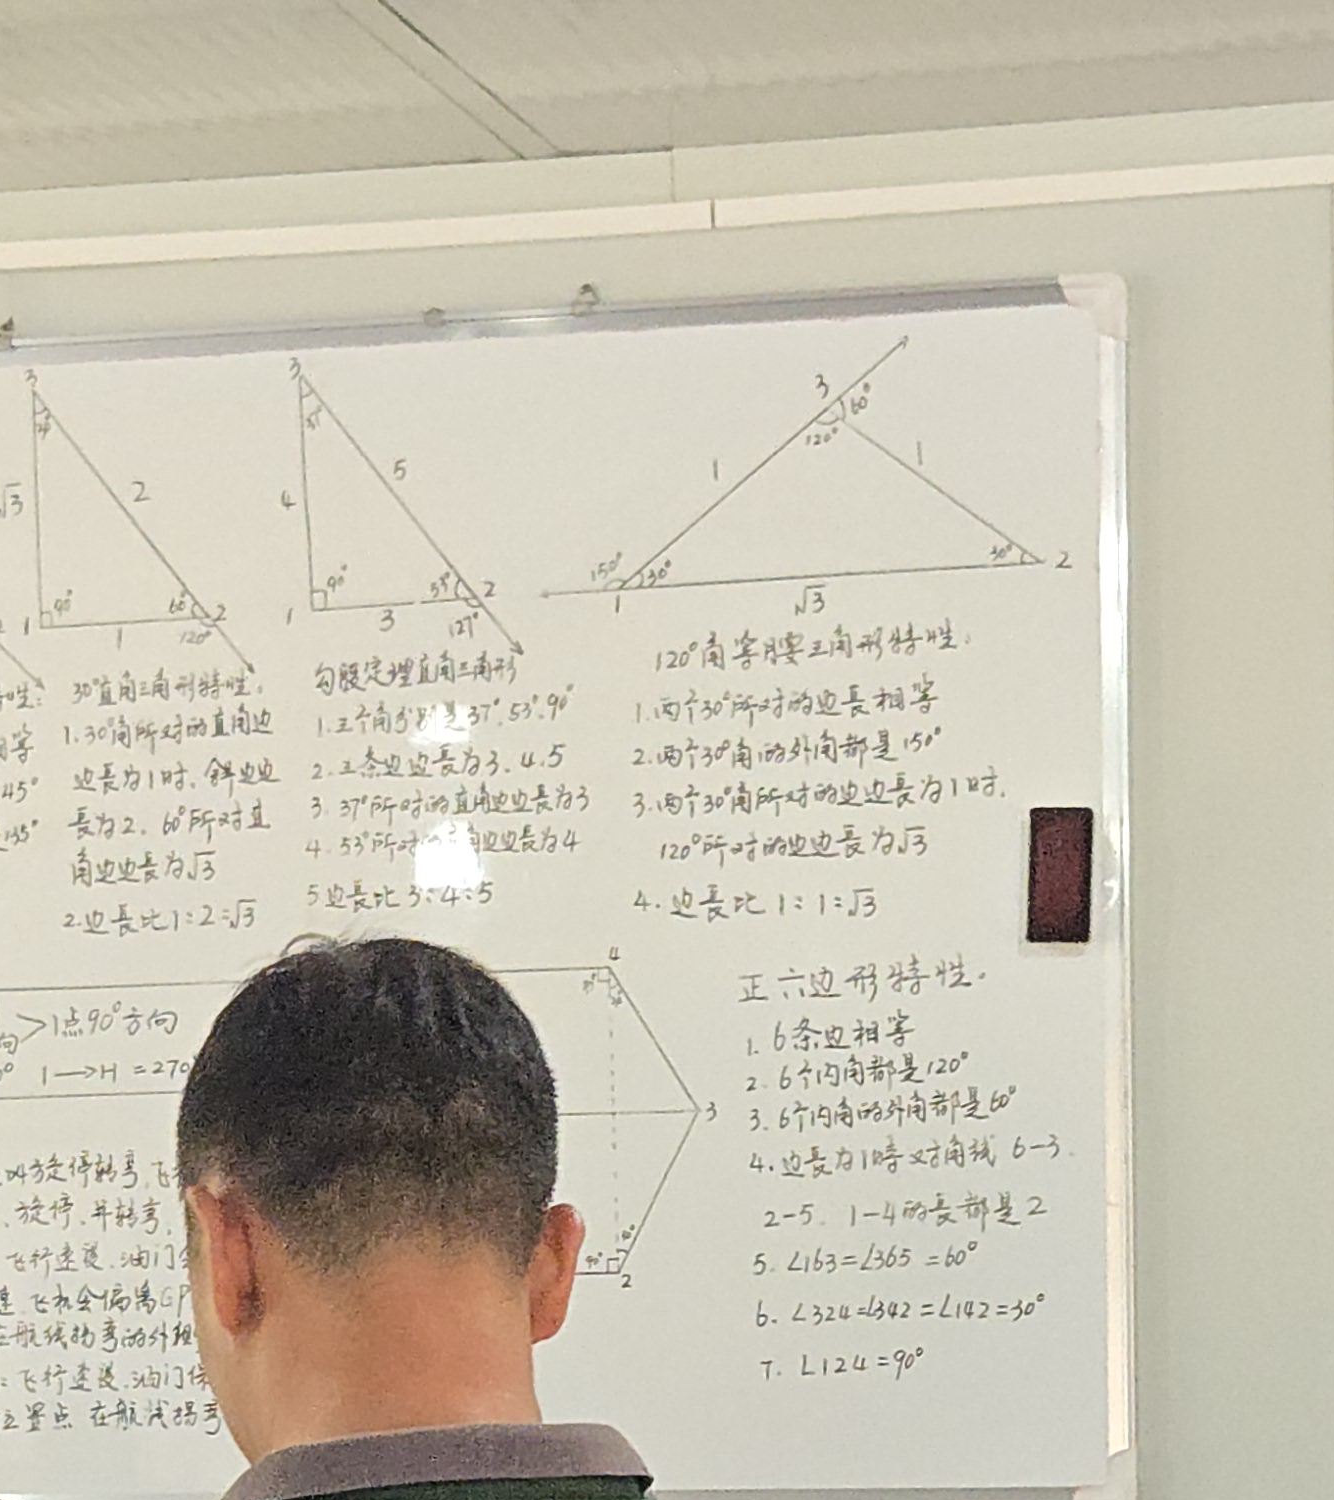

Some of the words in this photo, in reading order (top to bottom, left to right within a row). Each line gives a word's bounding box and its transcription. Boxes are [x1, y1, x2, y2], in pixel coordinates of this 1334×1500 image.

[287, 356, 303, 378] 3
[23, 369, 39, 386] 3
[814, 373, 829, 399] 3
[393, 458, 409, 481] 5
[131, 480, 152, 503] 2
[1055, 552, 1073, 570] 2
[482, 579, 497, 599] 2
[212, 602, 228, 622] 2
[379, 612, 397, 632] 3
[705, 1102, 719, 1122] 3
[621, 1273, 635, 1289] 2
